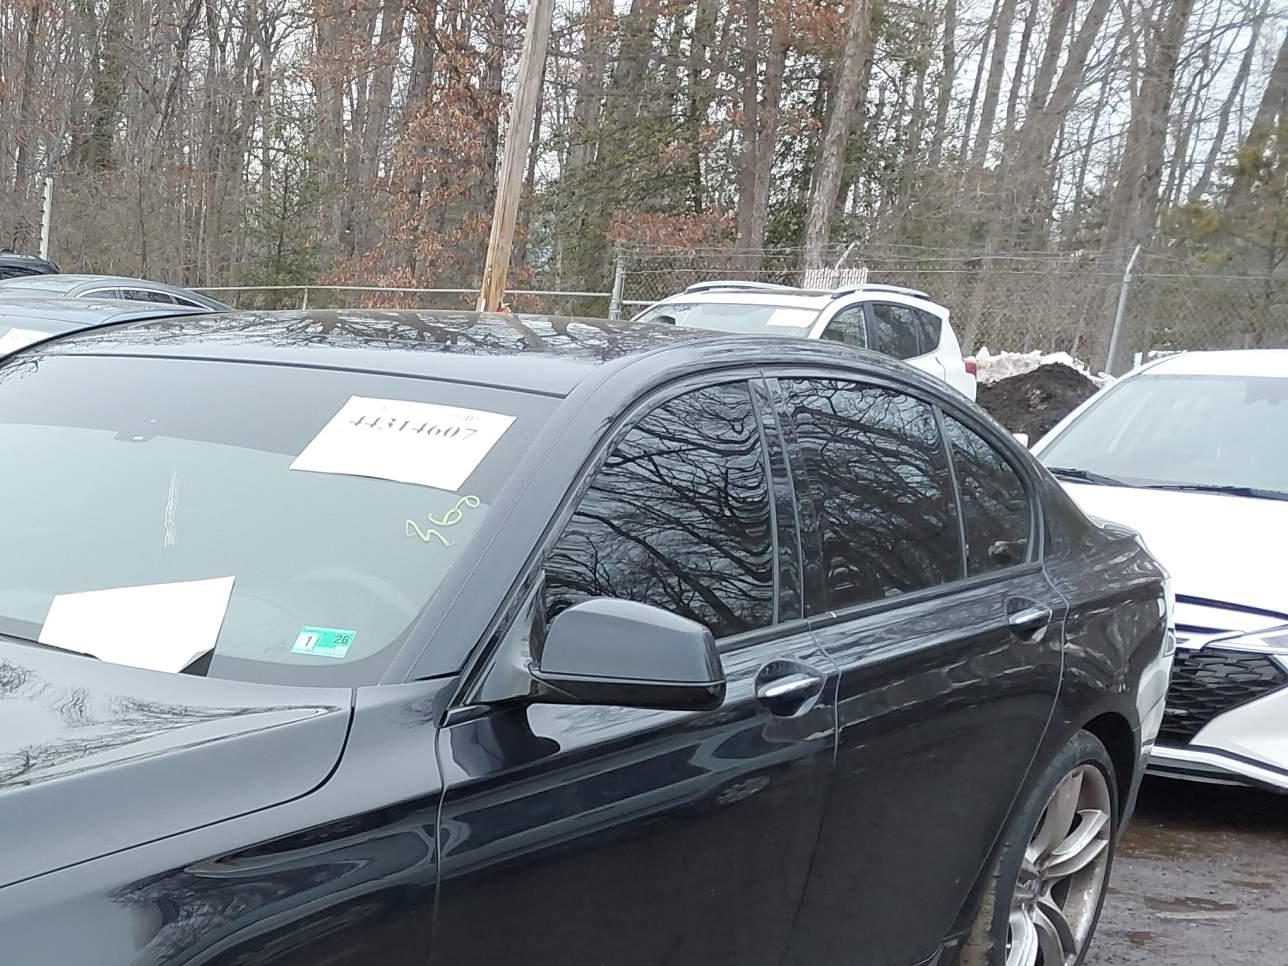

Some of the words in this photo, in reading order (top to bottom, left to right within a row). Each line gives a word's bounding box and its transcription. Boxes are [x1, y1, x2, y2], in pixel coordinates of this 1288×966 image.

[349, 415, 478, 440] 44314607
[304, 635, 313, 647] 1
[334, 634, 350, 646] 26
